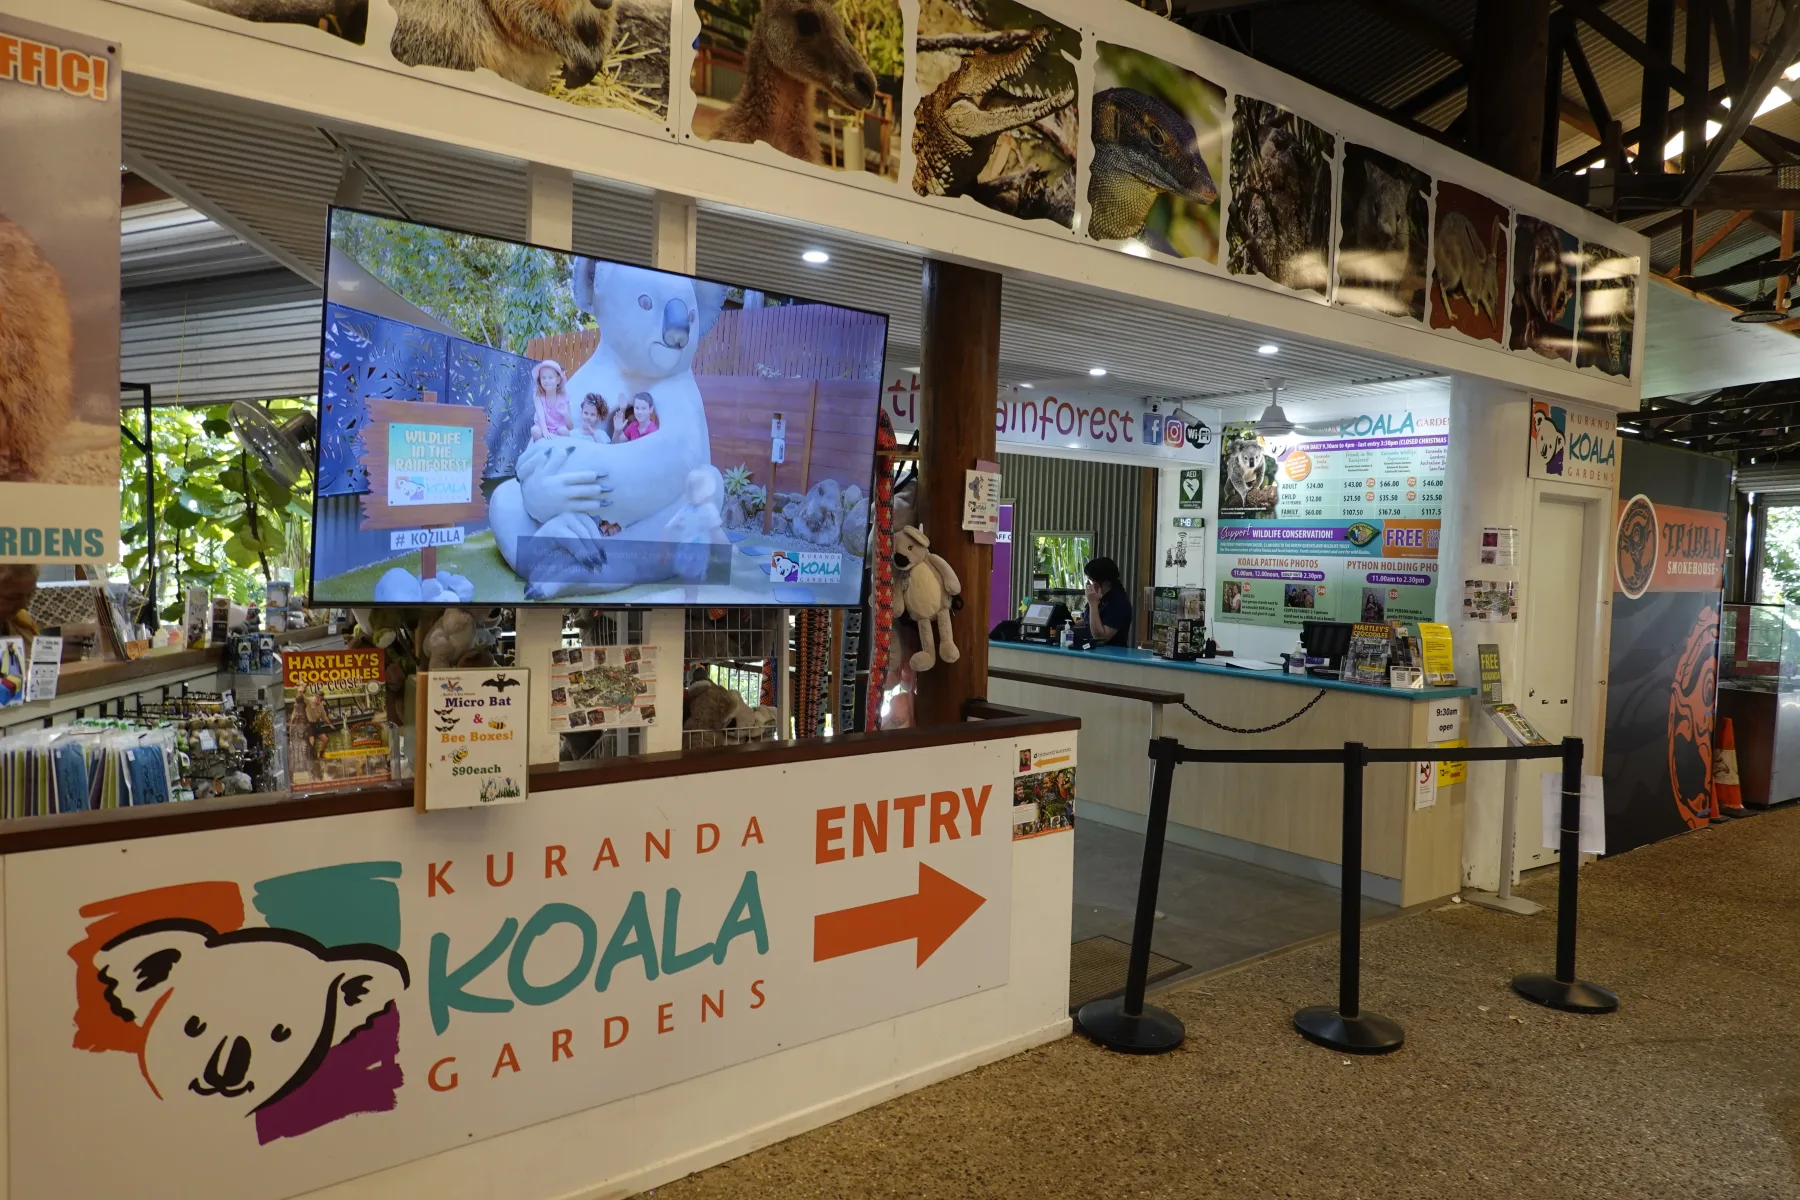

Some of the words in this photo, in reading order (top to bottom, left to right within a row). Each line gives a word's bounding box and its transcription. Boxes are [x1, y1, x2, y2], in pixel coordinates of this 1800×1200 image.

[995, 388, 1134, 442] ainforest
[1570, 413, 1616, 431] KURANDA
[1340, 412, 1414, 438] KOALA
[1416, 418, 1449, 428] GARDE
[405, 430, 461, 444] WILDLIFE
[428, 446, 451, 458] THE
[1569, 432, 1615, 466] KOALA
[394, 458, 468, 472] RAINFOREST
[1568, 467, 1614, 483] GARDENS
[411, 530, 460, 545] KOZILLA
[1220, 524, 1252, 541] Support
[1252, 530, 1281, 538] WILDLIFE
[1282, 530, 1334, 538] CONSERVATION!
[1386, 529, 1423, 546] FREE
[800, 562, 840, 575] KOALA
[1238, 558, 1258, 566] KOALA
[1260, 558, 1288, 567] PATTING
[1290, 560, 1318, 568] PHOTOS
[1347, 561, 1378, 570] PYTHON
[1380, 562, 1418, 571] HOLDING
[1420, 562, 1439, 572] PHO
[1667, 560, 1716, 575] SMOKEHOUSE
[1354, 624, 1389, 633] HARTLEY'S
[288, 653, 379, 670] HARTLEY'S
[1481, 654, 1499, 669] FREE
[289, 668, 379, 684] CROCODILES
[1483, 683, 1492, 692] MAP
[445, 698, 484, 708] Micro
[489, 696, 511, 706] Bat
[473, 714, 483, 724] &
[1436, 708, 1458, 716] 9:30am
[1439, 724, 1453, 732] open
[441, 733, 465, 743] Bee
[470, 730, 513, 742] Boxes!
[452, 764, 501, 776] $90each
[814, 785, 994, 865] ENTRY
[427, 816, 765, 898] KURANDA
[427, 870, 769, 1036] KOALA
[426, 979, 767, 1093] GARDENS
